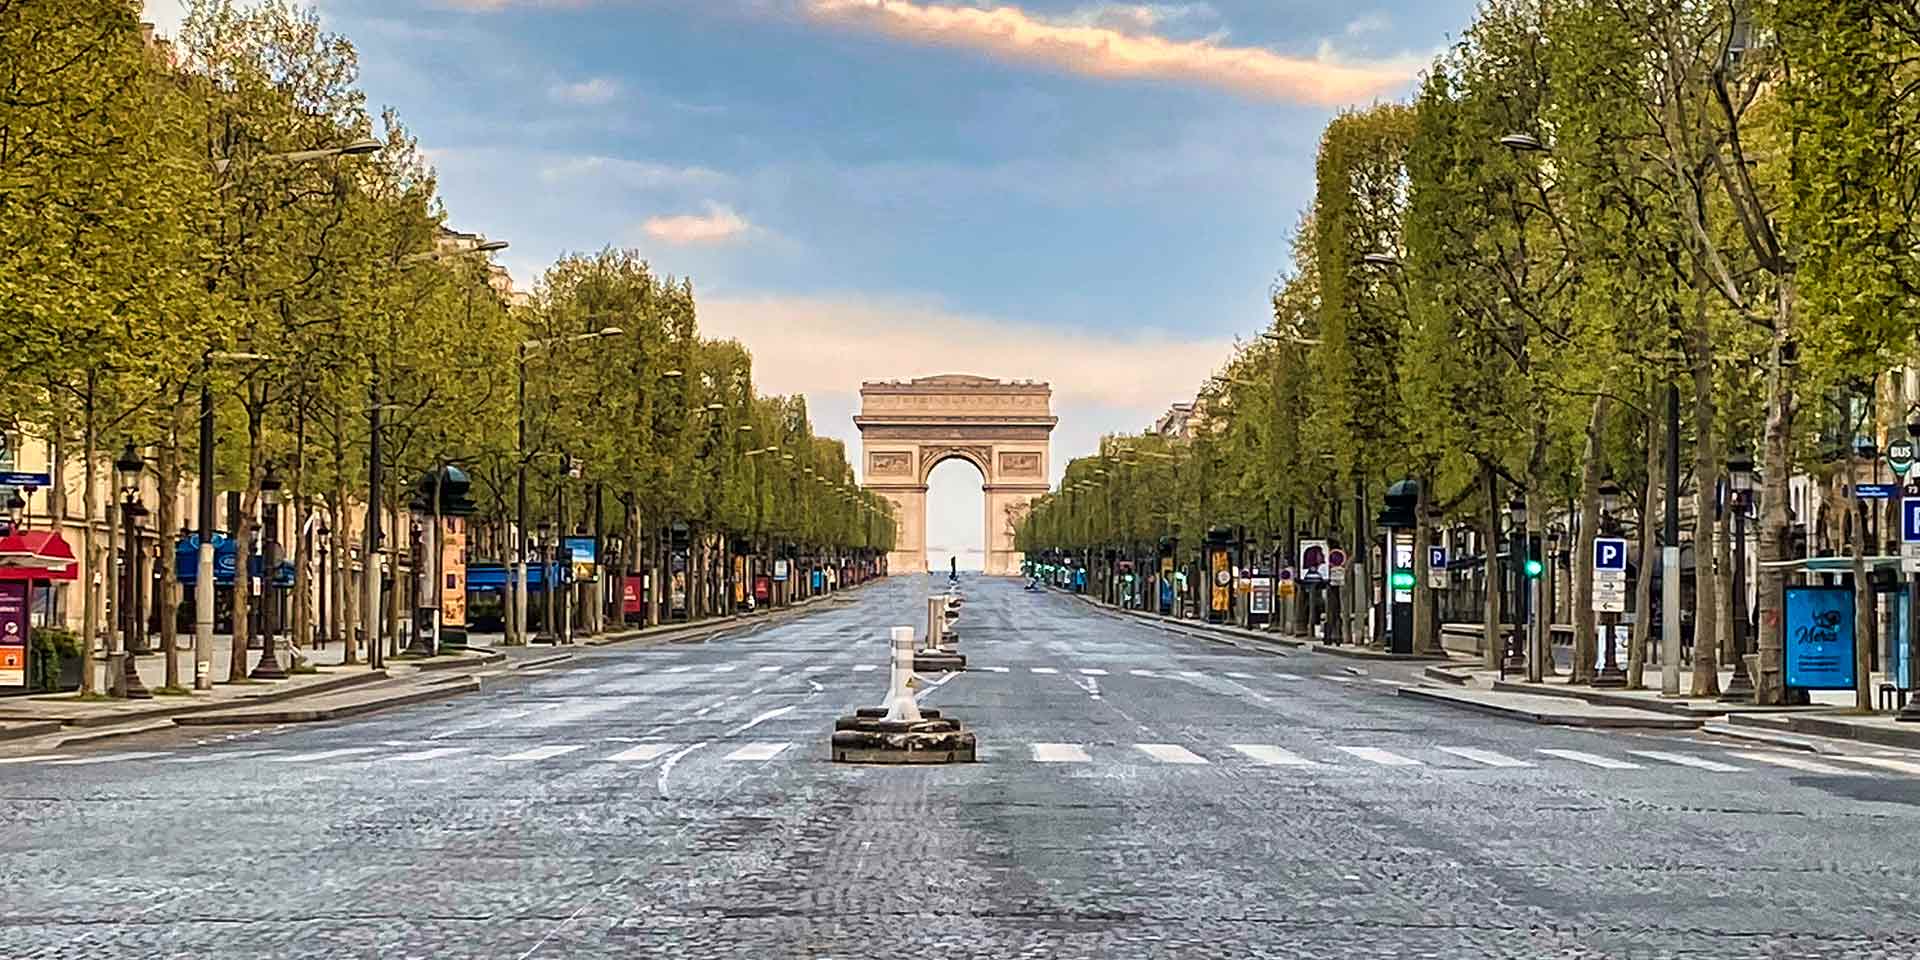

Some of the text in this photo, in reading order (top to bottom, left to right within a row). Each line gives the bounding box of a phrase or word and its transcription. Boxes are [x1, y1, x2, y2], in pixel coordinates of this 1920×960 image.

[1890, 446, 1912, 458] BUS
[1907, 485, 1919, 494] 73
[1433, 550, 1442, 565] P
[1602, 545, 1617, 565] P
